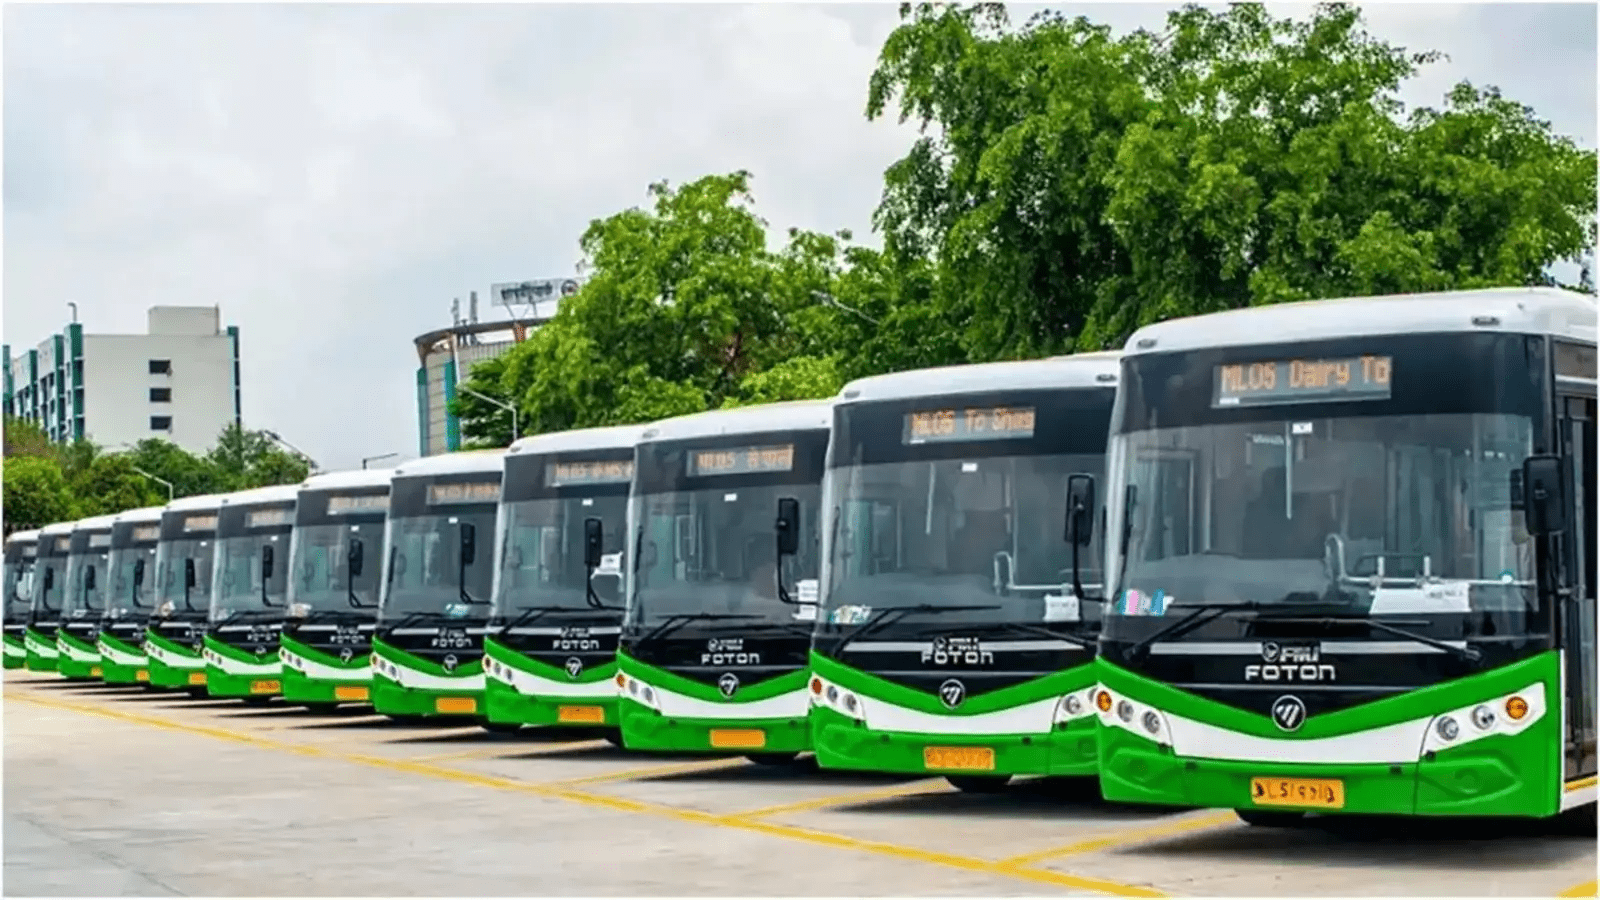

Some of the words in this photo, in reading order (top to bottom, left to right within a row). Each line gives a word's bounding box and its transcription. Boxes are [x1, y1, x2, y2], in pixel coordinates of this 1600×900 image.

[1289, 359, 1350, 388] Dairy
[1360, 356, 1392, 384] To
[553, 639, 601, 651] FOTON
[701, 652, 761, 665] FOTON
[921, 650, 994, 665] FOTON
[1245, 664, 1336, 681] FOTON
